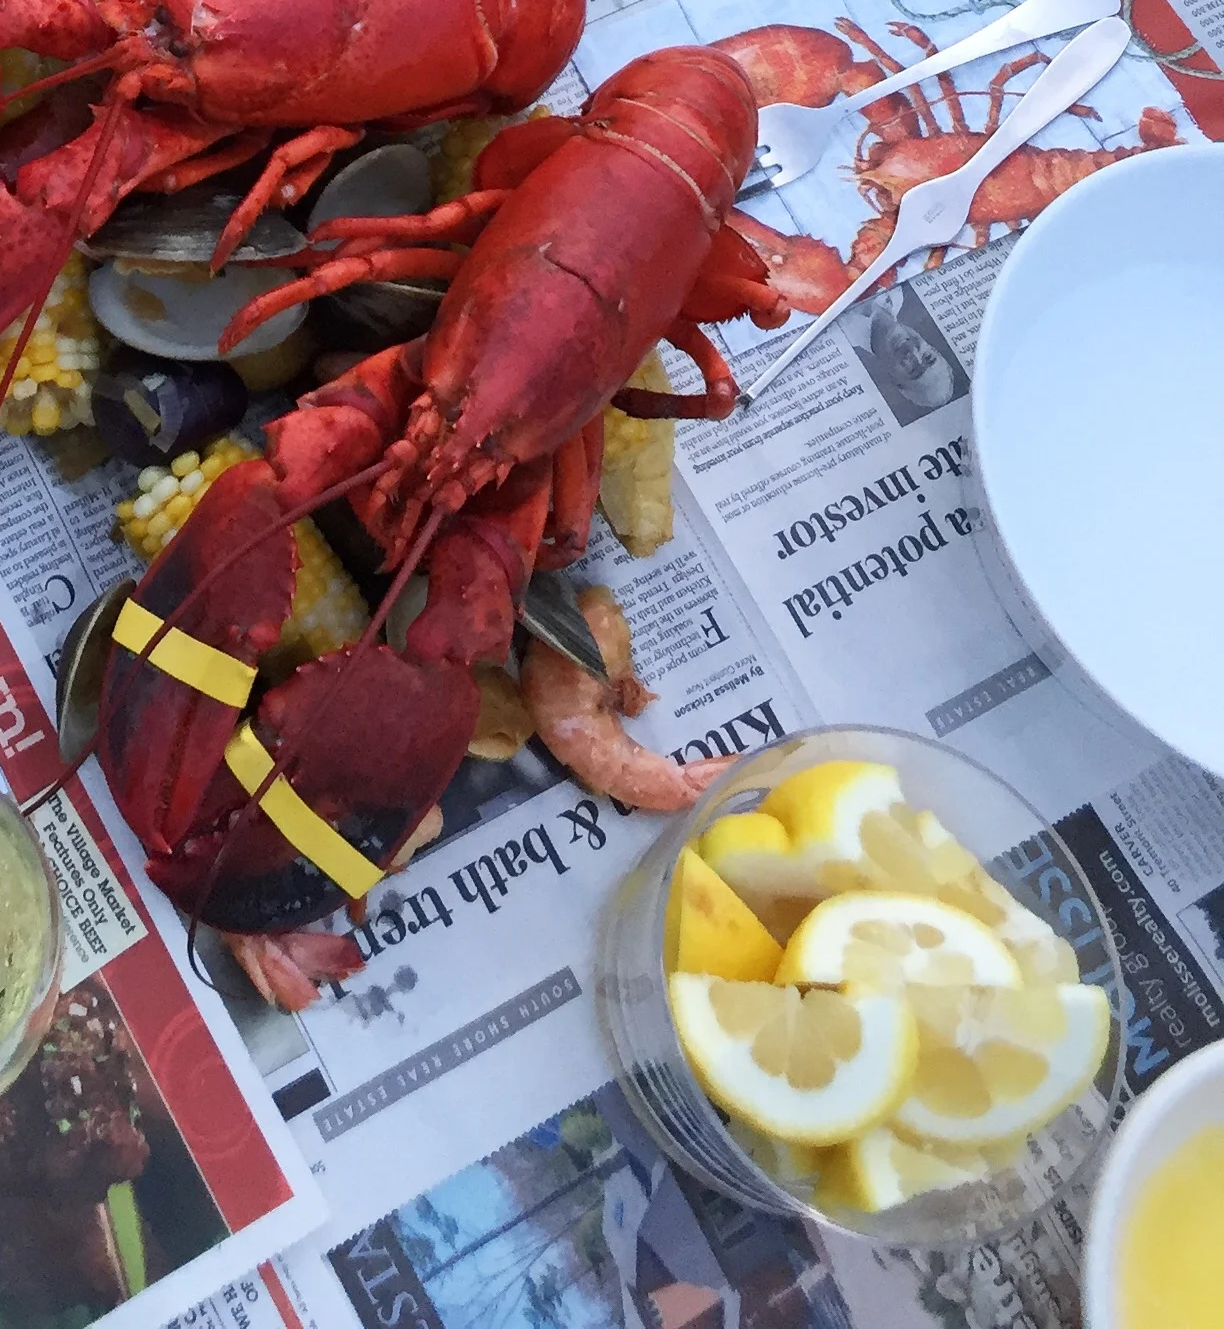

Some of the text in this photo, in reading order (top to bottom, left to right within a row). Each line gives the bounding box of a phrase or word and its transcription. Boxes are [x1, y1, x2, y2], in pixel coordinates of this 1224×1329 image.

[768, 464, 924, 564] investor
[942, 506, 974, 542] a
[781, 514, 954, 638] potential
[651, 629, 701, 662] technology
[673, 664, 764, 719] By Melissa Erickson
[931, 665, 1036, 731] REAL ESTATE
[1109, 792, 1138, 826] Street
[1113, 825, 1155, 873] CARVER
[38, 821, 112, 928] Features Only
[45, 792, 141, 935] The Village Market
[339, 796, 615, 973] & bath tren
[75, 918, 108, 957] BEEF
[1098, 849, 1221, 1028] molisserealty.com
[1140, 972, 1189, 1052] realty
[320, 977, 575, 1132] SOUTH SHORE REAL ESTATE
